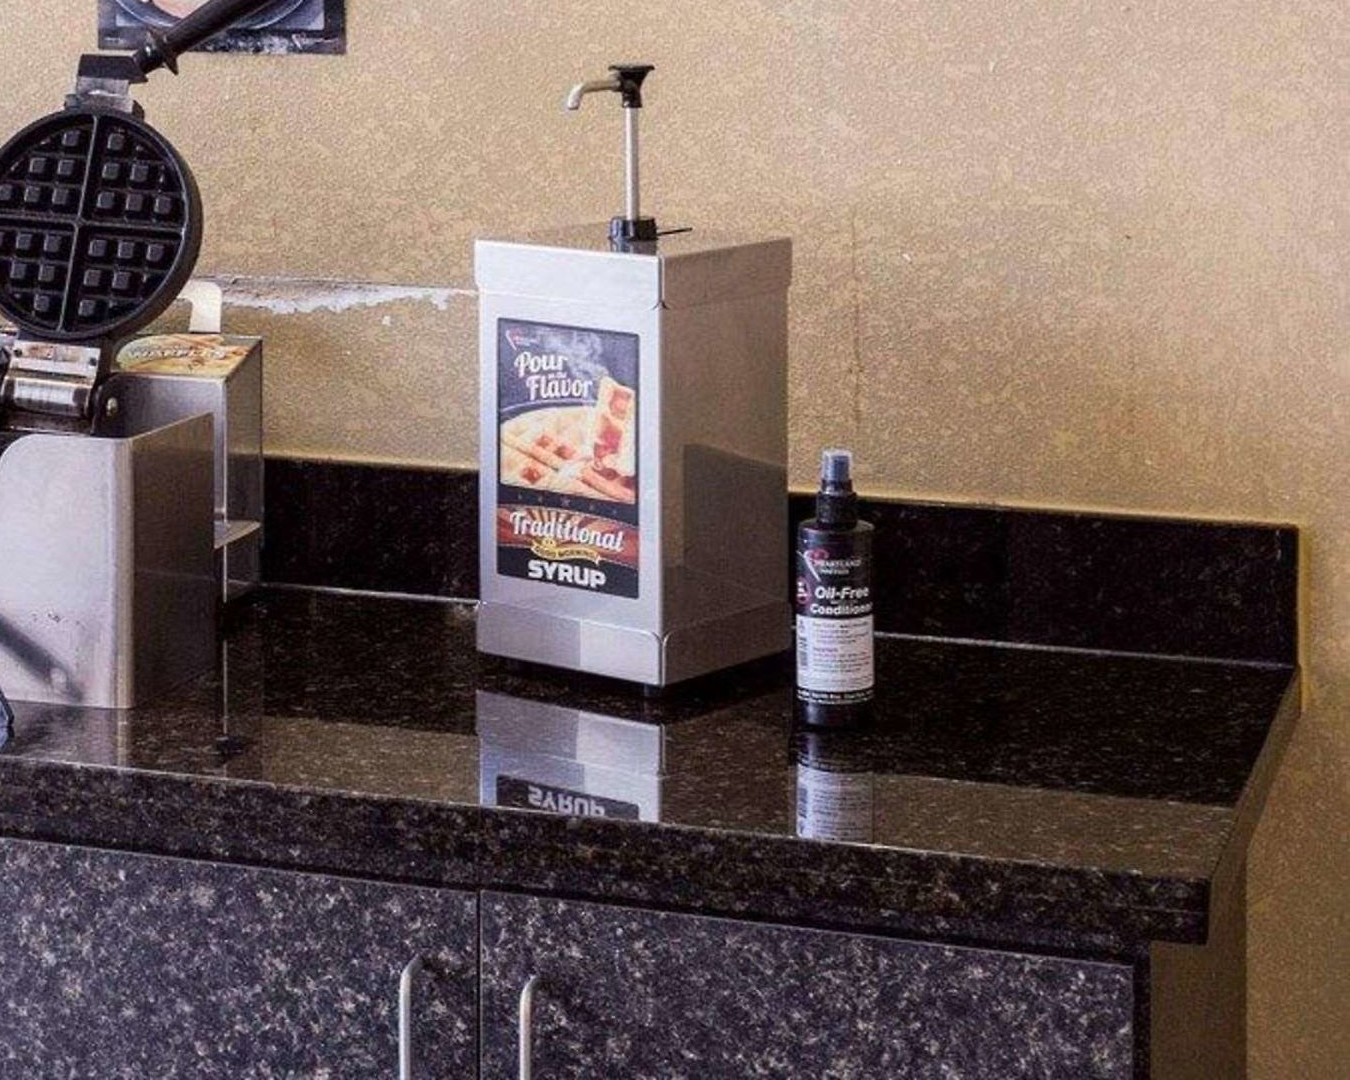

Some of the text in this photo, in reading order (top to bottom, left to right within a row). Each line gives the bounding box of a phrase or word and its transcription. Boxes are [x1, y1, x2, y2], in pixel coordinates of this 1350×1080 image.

[514, 351, 568, 378] Pour
[526, 374, 593, 400] Flavor
[511, 511, 624, 552] Traditional
[528, 559, 607, 588] SYRUP
[815, 586, 869, 600] Oil-Free
